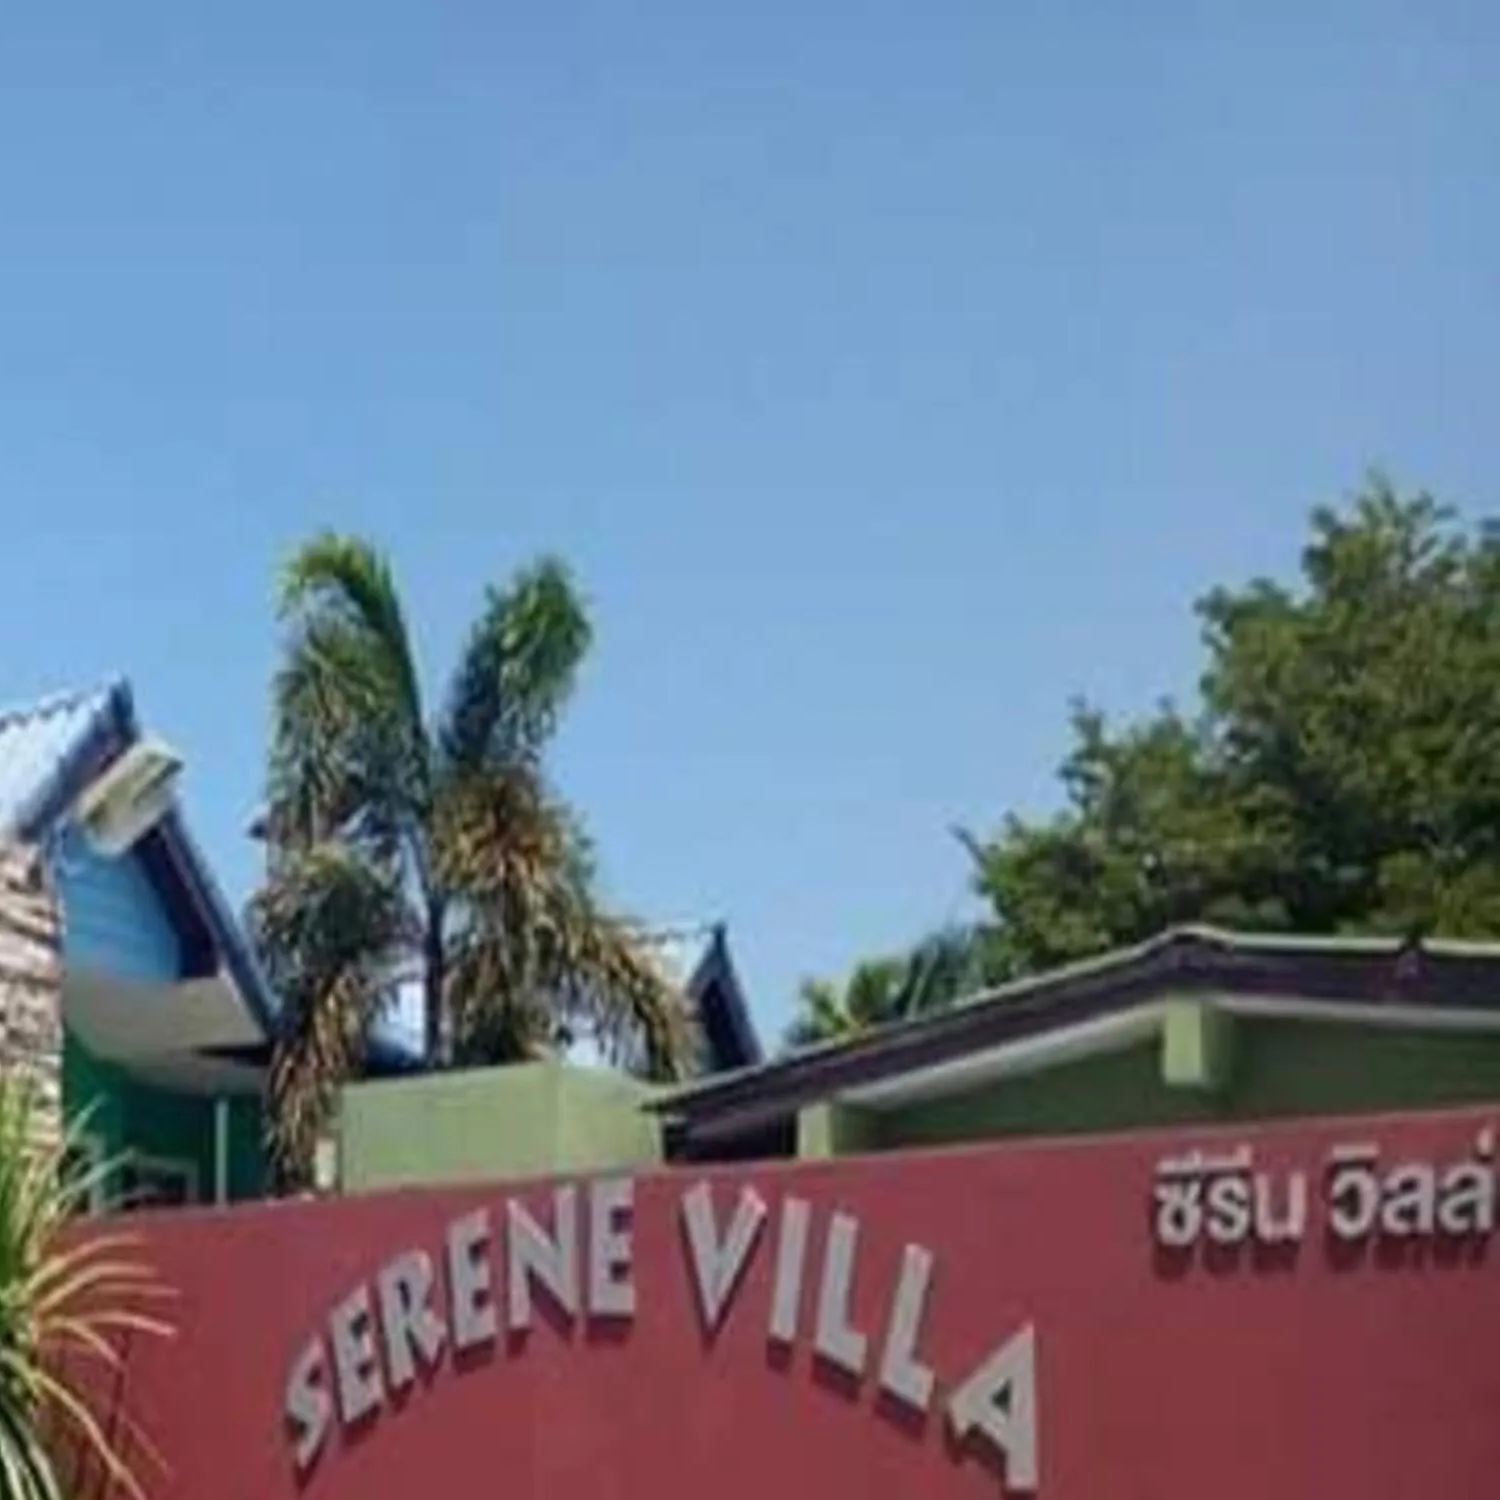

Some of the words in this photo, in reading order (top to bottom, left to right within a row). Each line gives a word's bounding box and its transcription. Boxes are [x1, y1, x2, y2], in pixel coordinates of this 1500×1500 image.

[1329, 1125, 1494, 1240] วิลล่
[283, 1177, 636, 1472] SERENE
[680, 1180, 1040, 1495] VILLA
